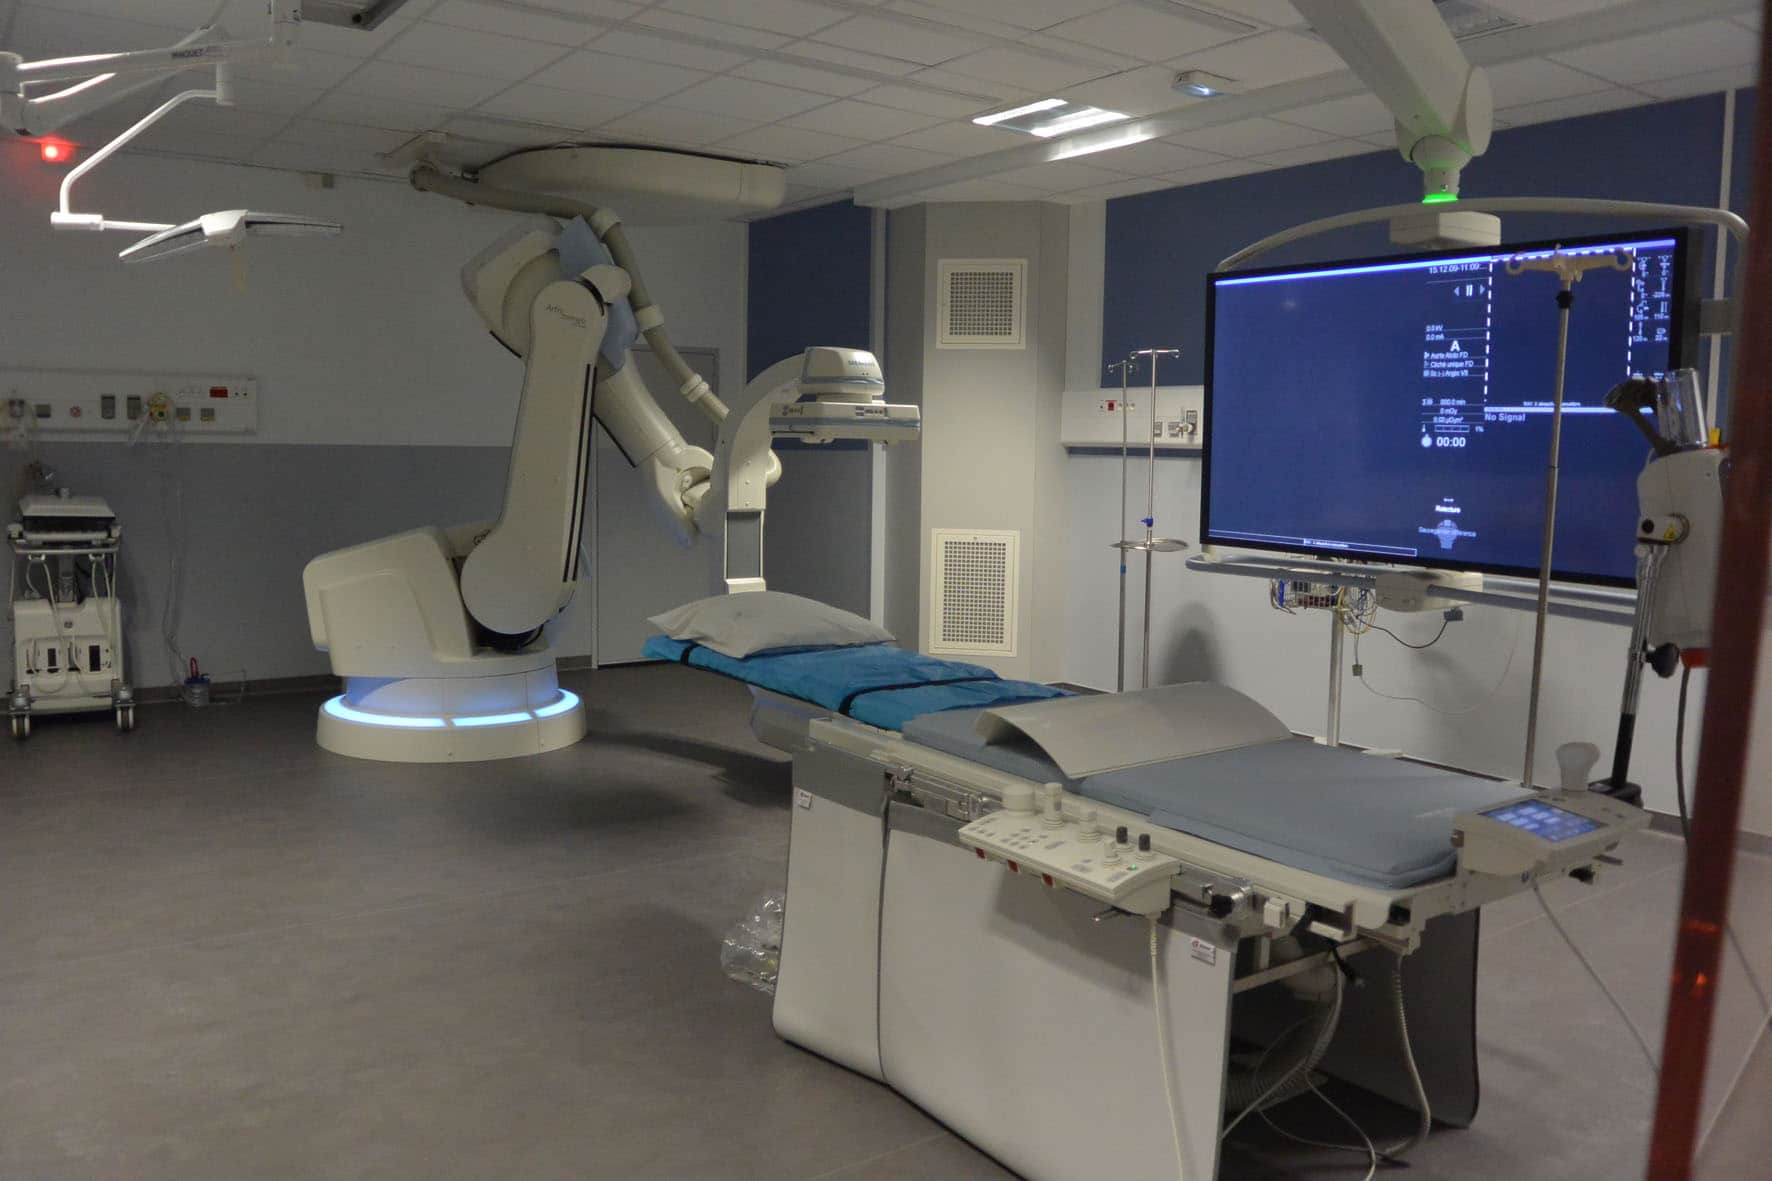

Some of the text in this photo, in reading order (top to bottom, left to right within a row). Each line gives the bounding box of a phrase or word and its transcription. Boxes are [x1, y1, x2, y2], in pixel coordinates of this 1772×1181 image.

[1450, 340, 1460, 351] A
[1485, 413, 1526, 423] No Signal
[1436, 436, 1466, 447] 00:00
